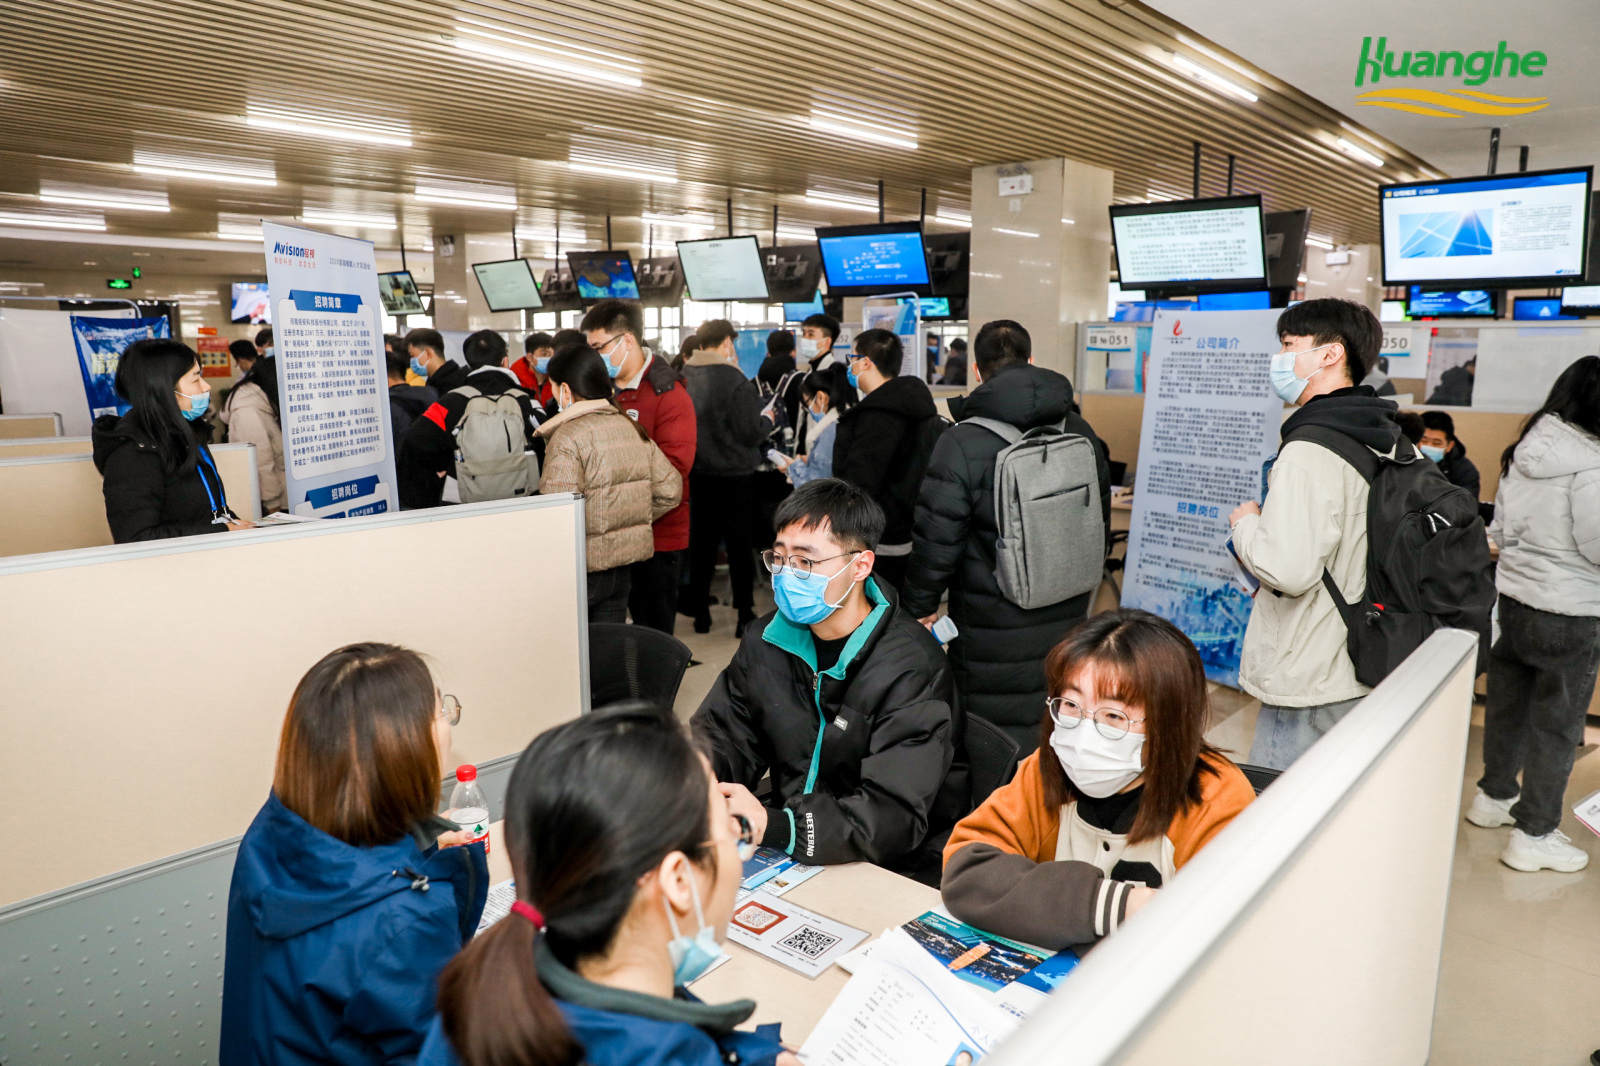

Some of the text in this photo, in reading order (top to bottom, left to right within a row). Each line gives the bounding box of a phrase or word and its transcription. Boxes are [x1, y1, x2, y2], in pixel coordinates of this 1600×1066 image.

[314, 295, 342, 309] 招聘简章
[1109, 335, 1128, 345] 051
[1196, 337, 1240, 349] 公司简介
[331, 483, 358, 501] 招聘岗位
[1177, 502, 1219, 518] 招聘岗位
[805, 812, 815, 857] BEETERNO
